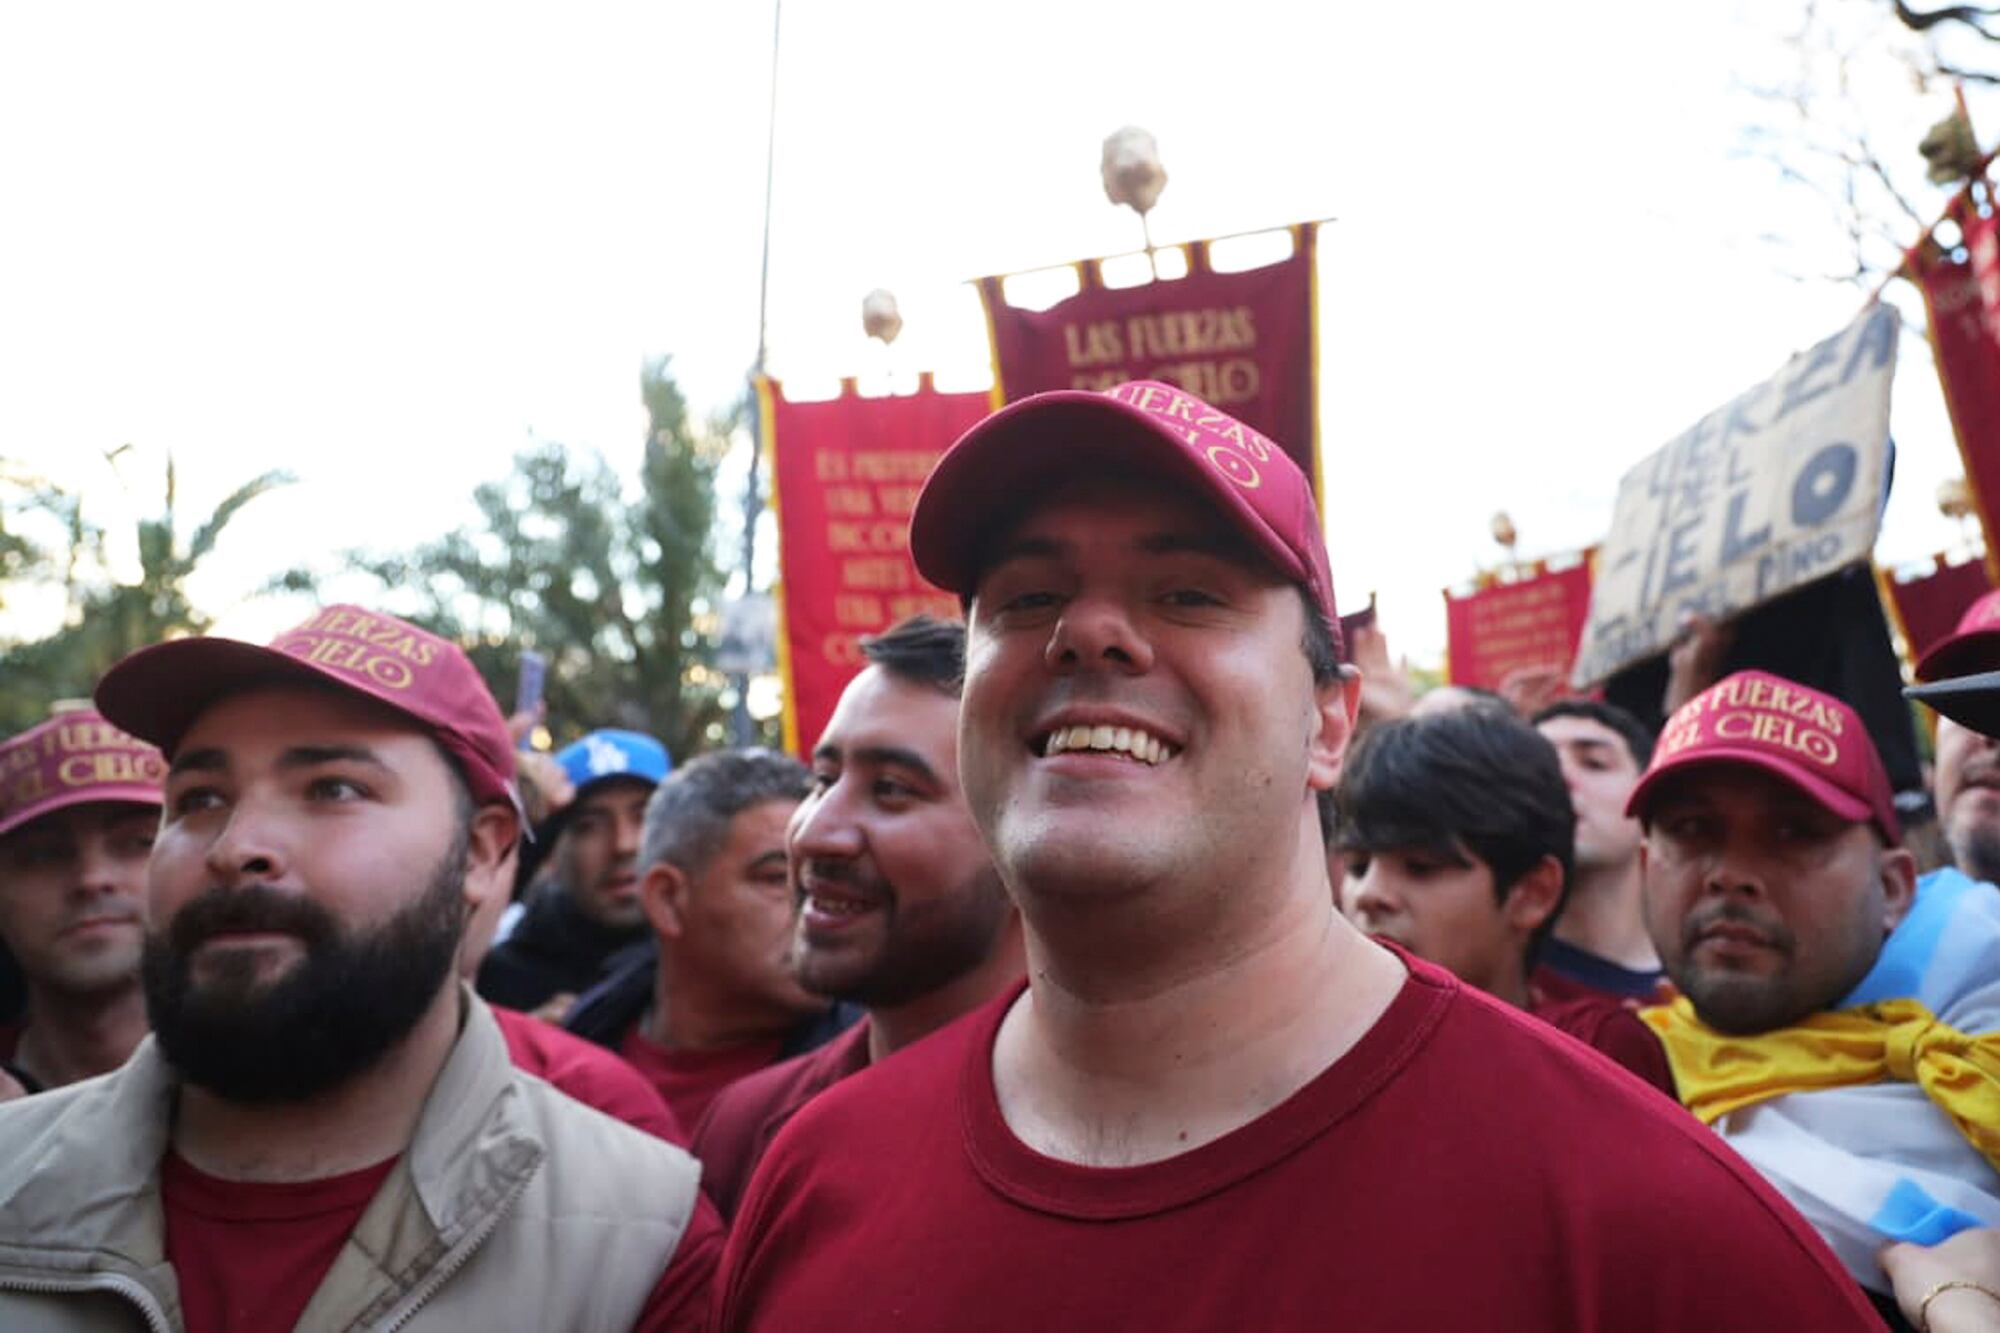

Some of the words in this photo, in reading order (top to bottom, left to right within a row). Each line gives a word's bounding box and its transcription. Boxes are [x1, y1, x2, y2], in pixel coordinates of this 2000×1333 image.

[1064, 320, 1123, 366] LAS
[1104, 385, 1272, 463] UERZAS
[302, 612, 438, 666] UERZAS
[1710, 679, 1844, 735] FUERZAS
[1715, 711, 1838, 765] CIELO
